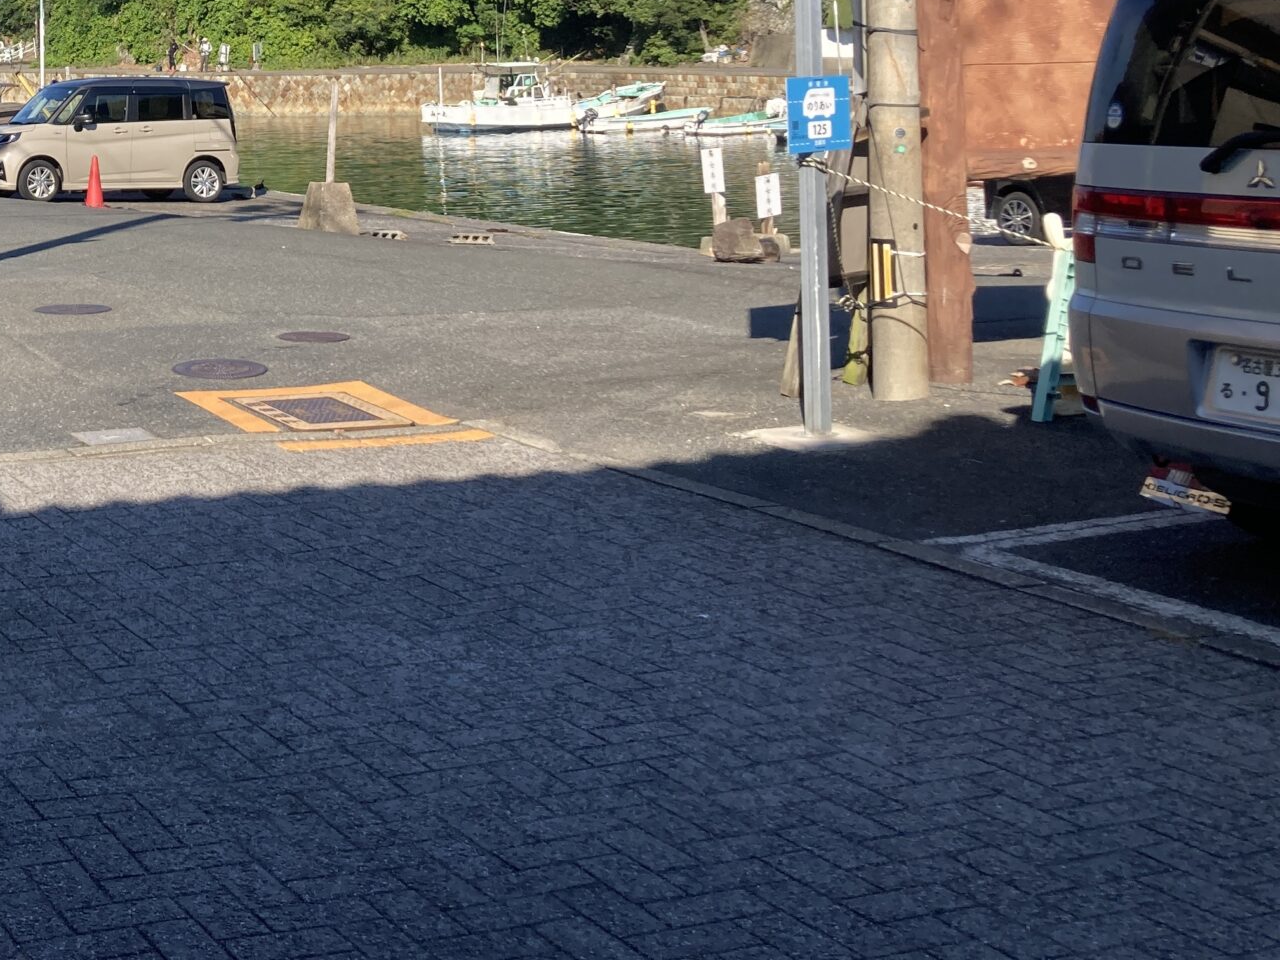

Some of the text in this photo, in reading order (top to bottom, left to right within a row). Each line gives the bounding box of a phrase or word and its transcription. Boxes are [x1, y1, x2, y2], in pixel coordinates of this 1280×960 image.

[807, 100, 833, 111] のりあい
[812, 123, 827, 136] 125
